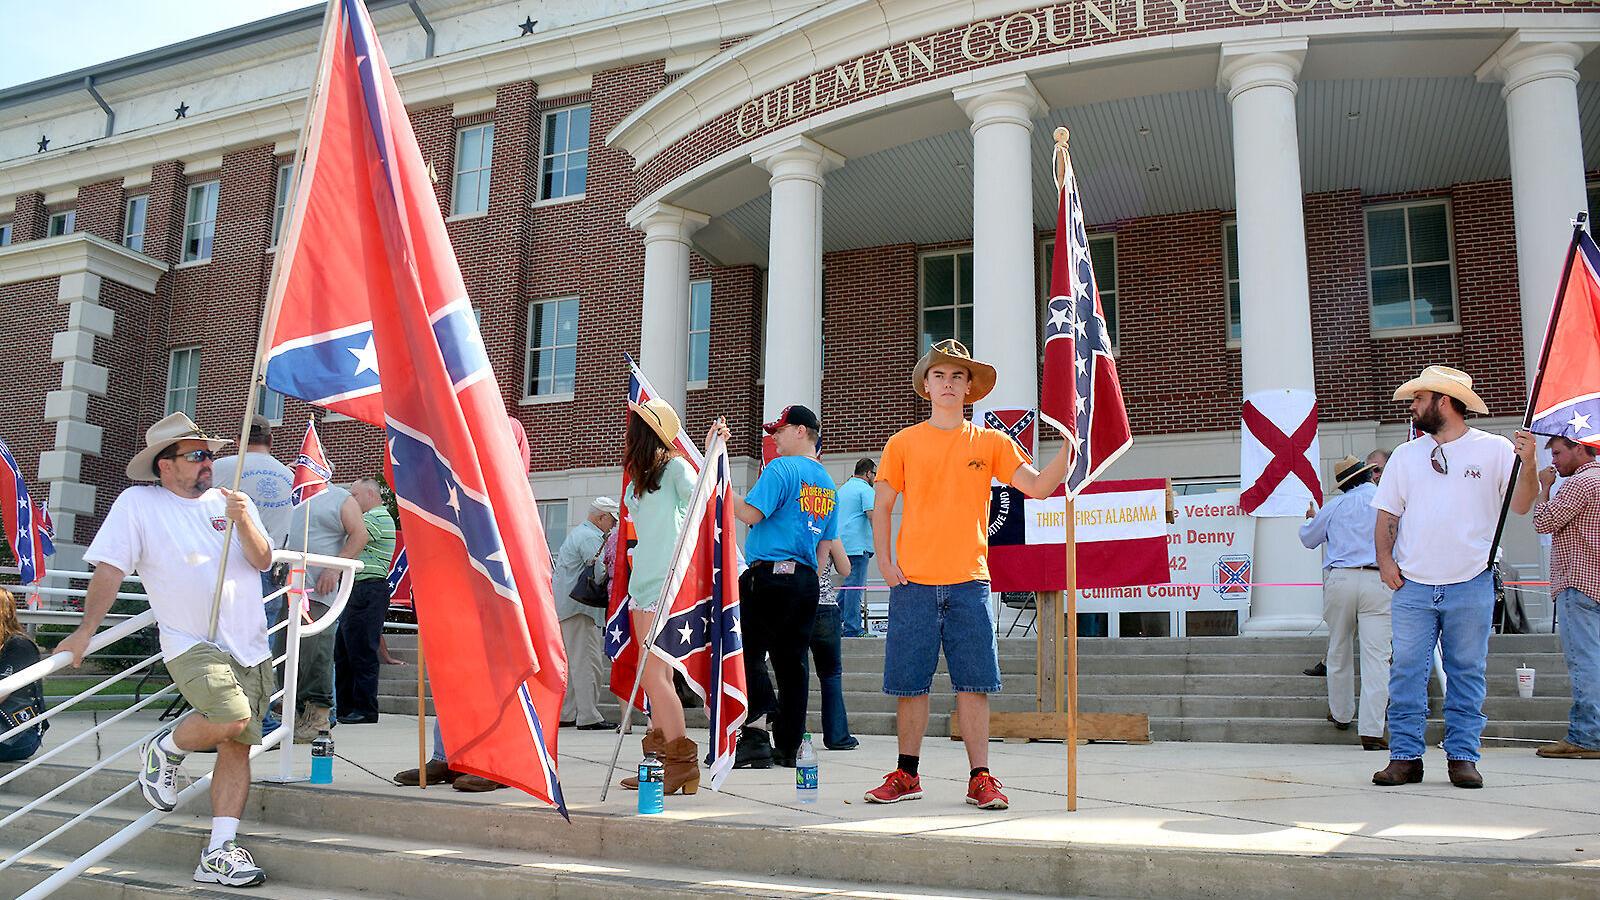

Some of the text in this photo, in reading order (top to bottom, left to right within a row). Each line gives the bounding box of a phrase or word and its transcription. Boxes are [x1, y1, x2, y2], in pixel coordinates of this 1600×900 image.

[736, 0, 1190, 138] CULLMAN COUNTY
[800, 497, 811, 512] IS
[1184, 503, 1246, 518] Veteran
[986, 491, 1010, 538] ATIVE LAND
[1036, 505, 1157, 528] THIRT FIRST ALABAMA
[1187, 529, 1235, 547] Denny
[1147, 583, 1201, 601] County
